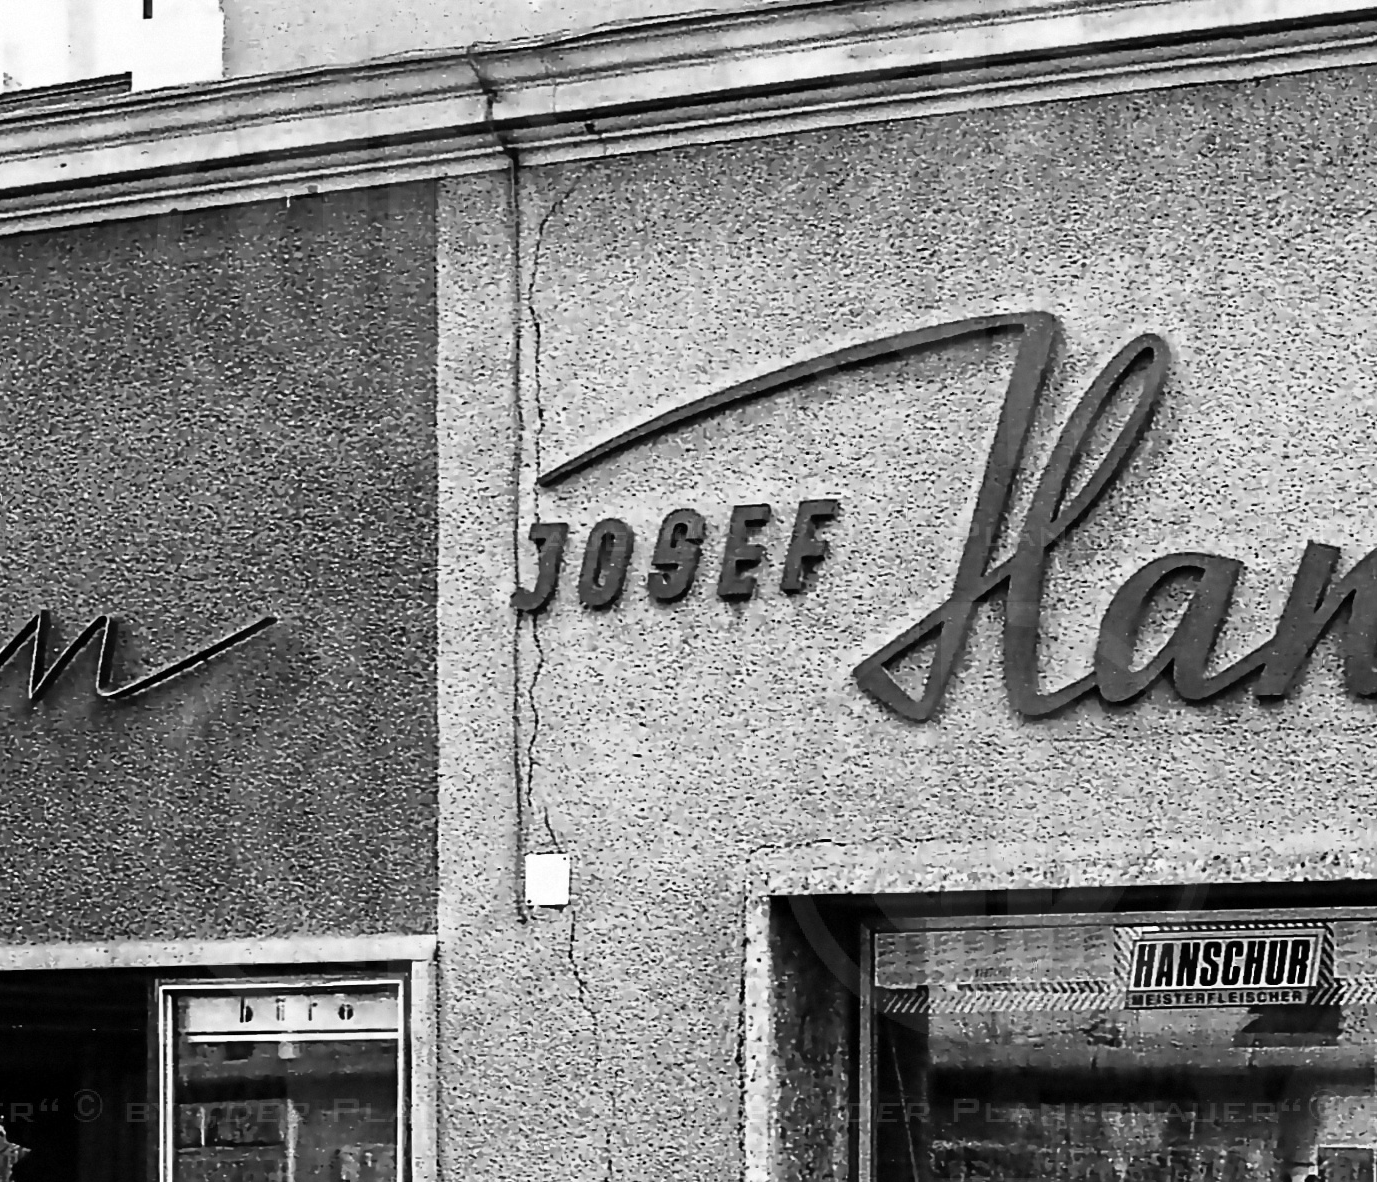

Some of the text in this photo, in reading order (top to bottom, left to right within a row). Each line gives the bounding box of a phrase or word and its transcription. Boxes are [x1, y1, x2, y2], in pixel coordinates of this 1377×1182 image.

[512, 498, 841, 613] JOSEF
[1133, 939, 1312, 989] HANSCHUR
[1130, 990, 1303, 1006] MEISTERFLEISCHER
